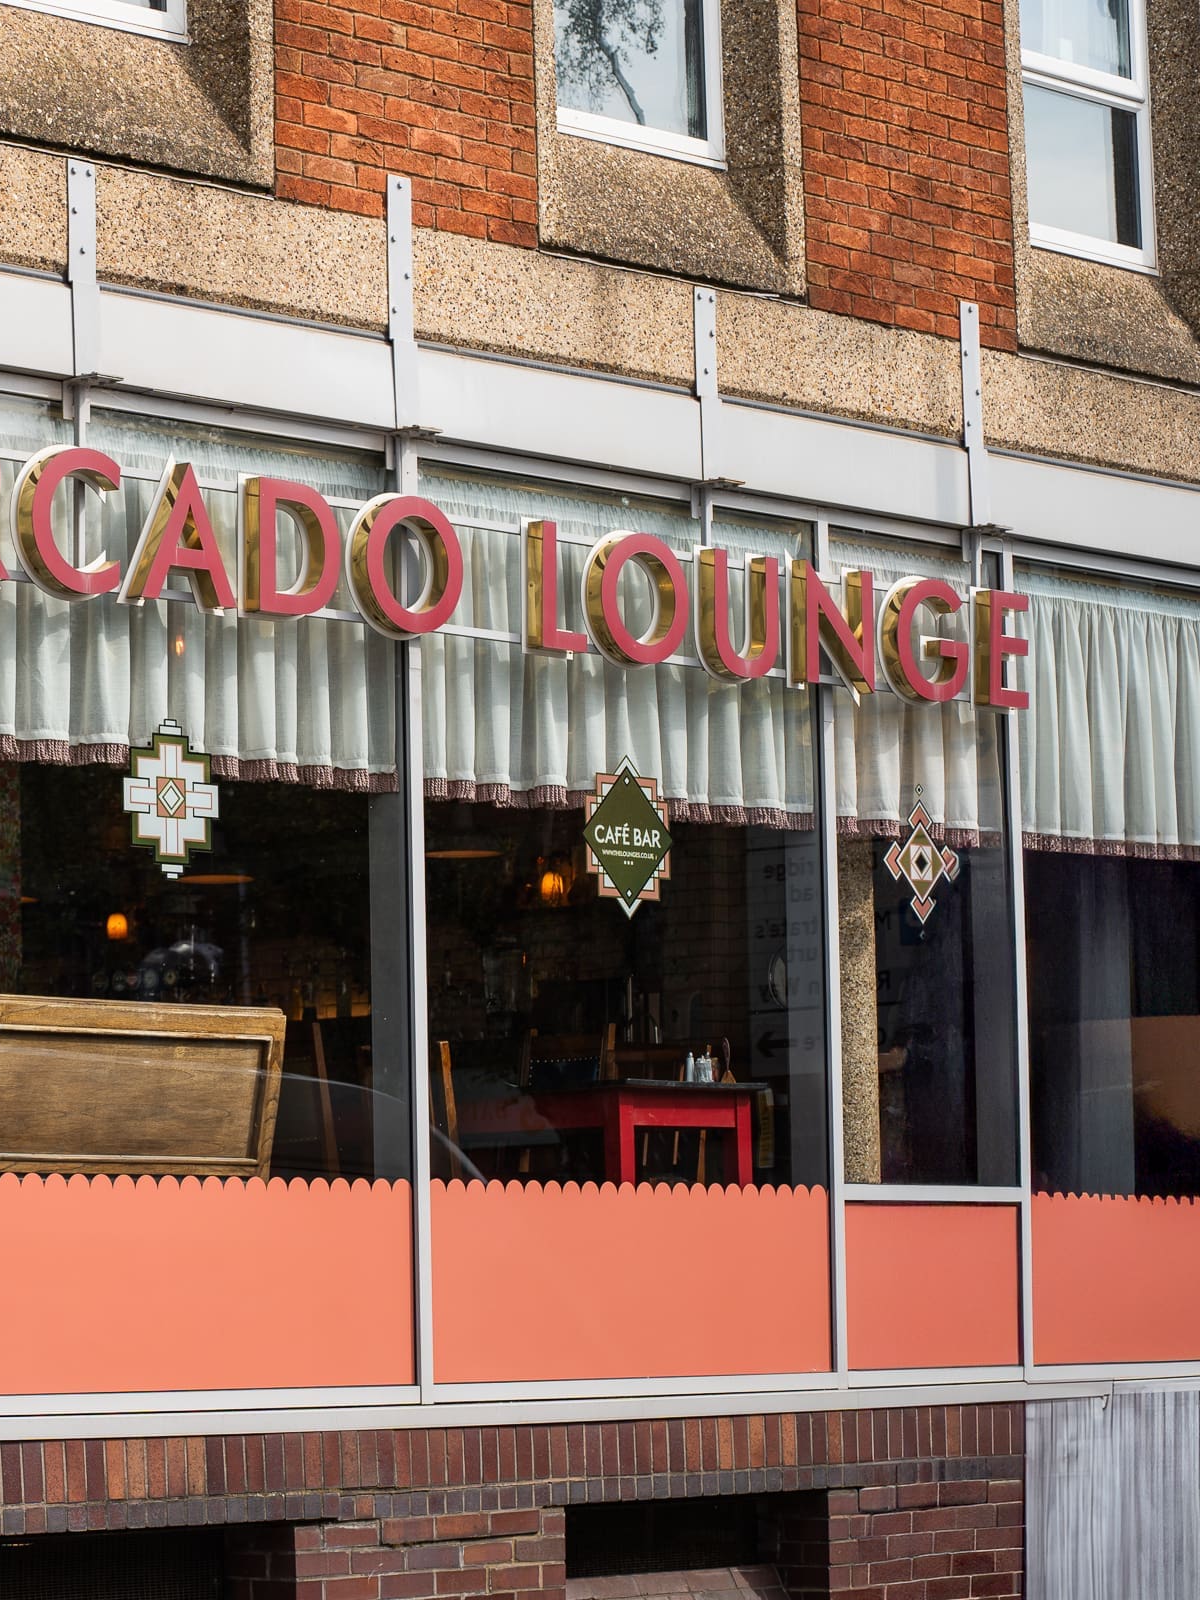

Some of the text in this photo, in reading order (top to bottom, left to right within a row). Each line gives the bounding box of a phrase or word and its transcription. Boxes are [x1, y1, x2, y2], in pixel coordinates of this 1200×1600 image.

[522, 517, 1029, 709] LOUNGE
[594, 823, 661, 848] CAFÉ BAR
